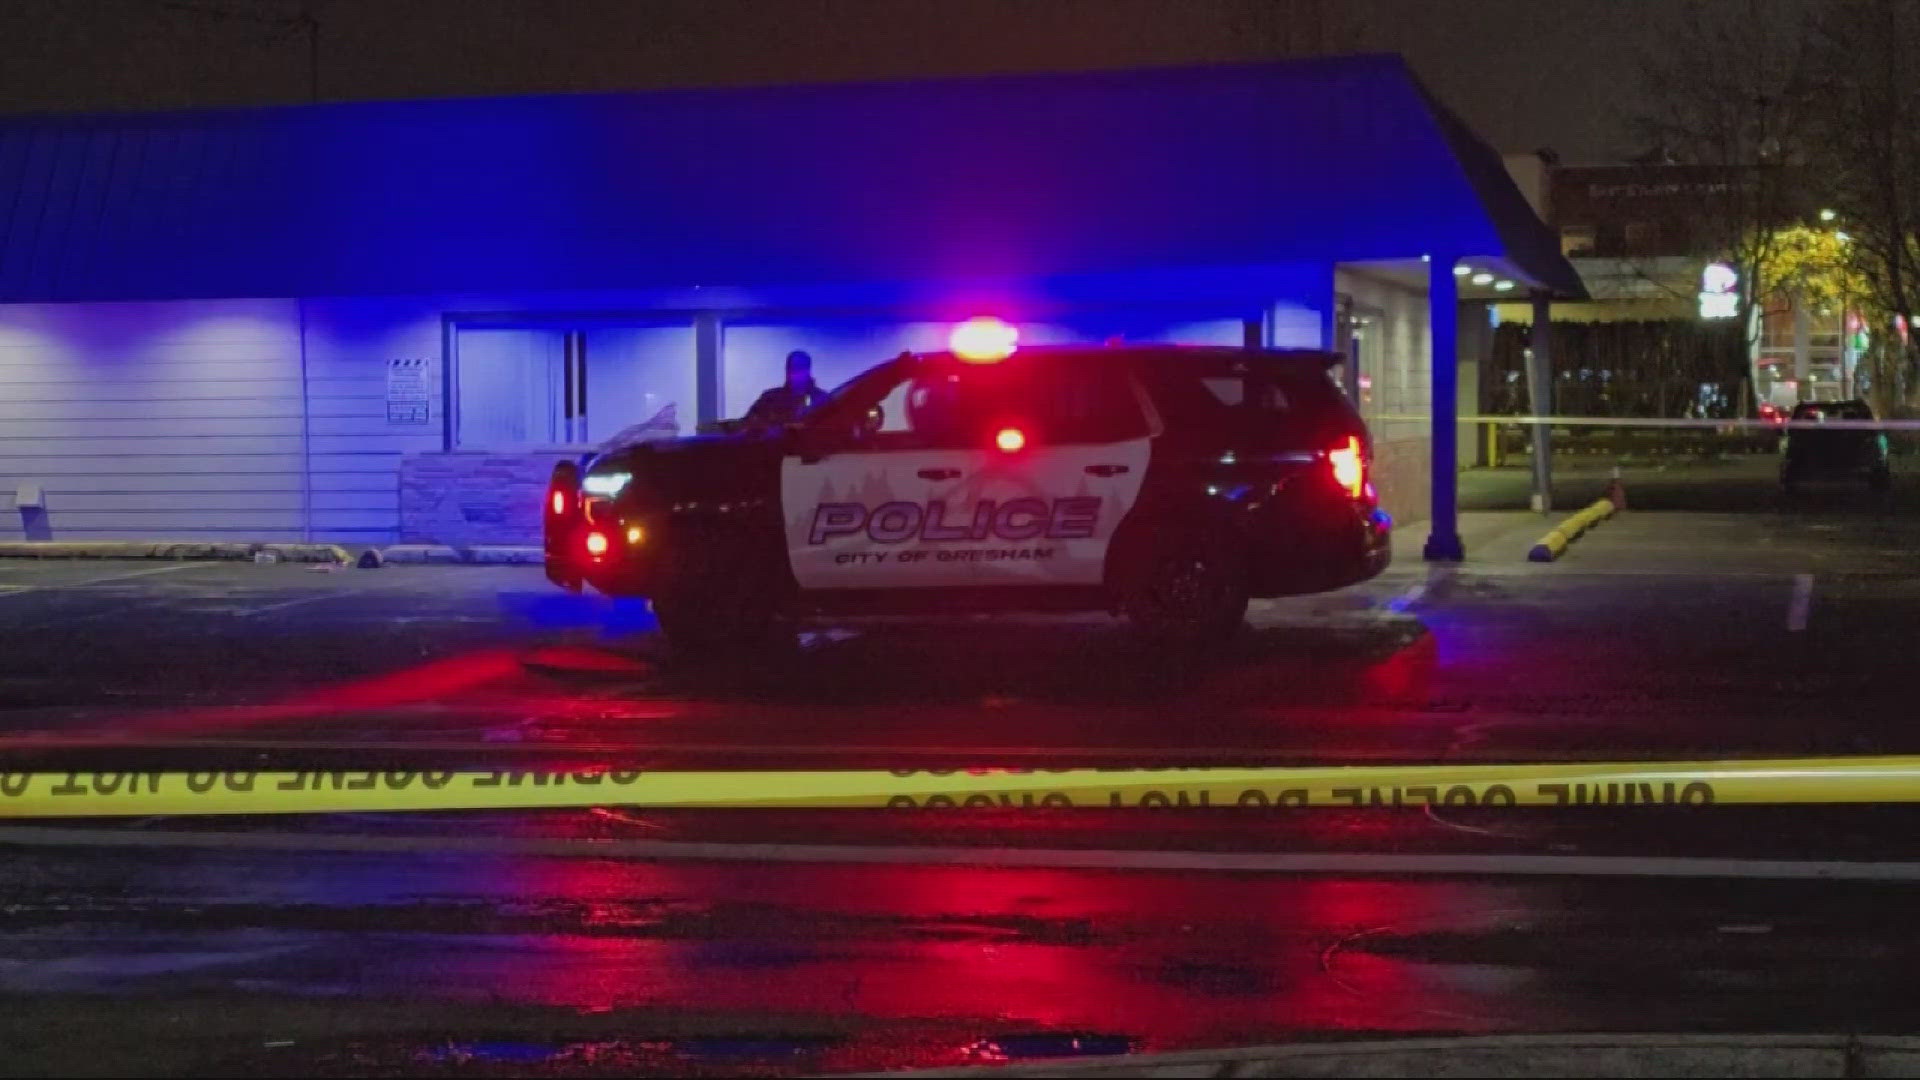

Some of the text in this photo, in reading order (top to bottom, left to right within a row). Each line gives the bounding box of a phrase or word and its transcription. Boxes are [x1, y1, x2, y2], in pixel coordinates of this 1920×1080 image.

[808, 497, 1103, 545] POLICE
[835, 548, 1055, 565] CITY OF GRESHAM
